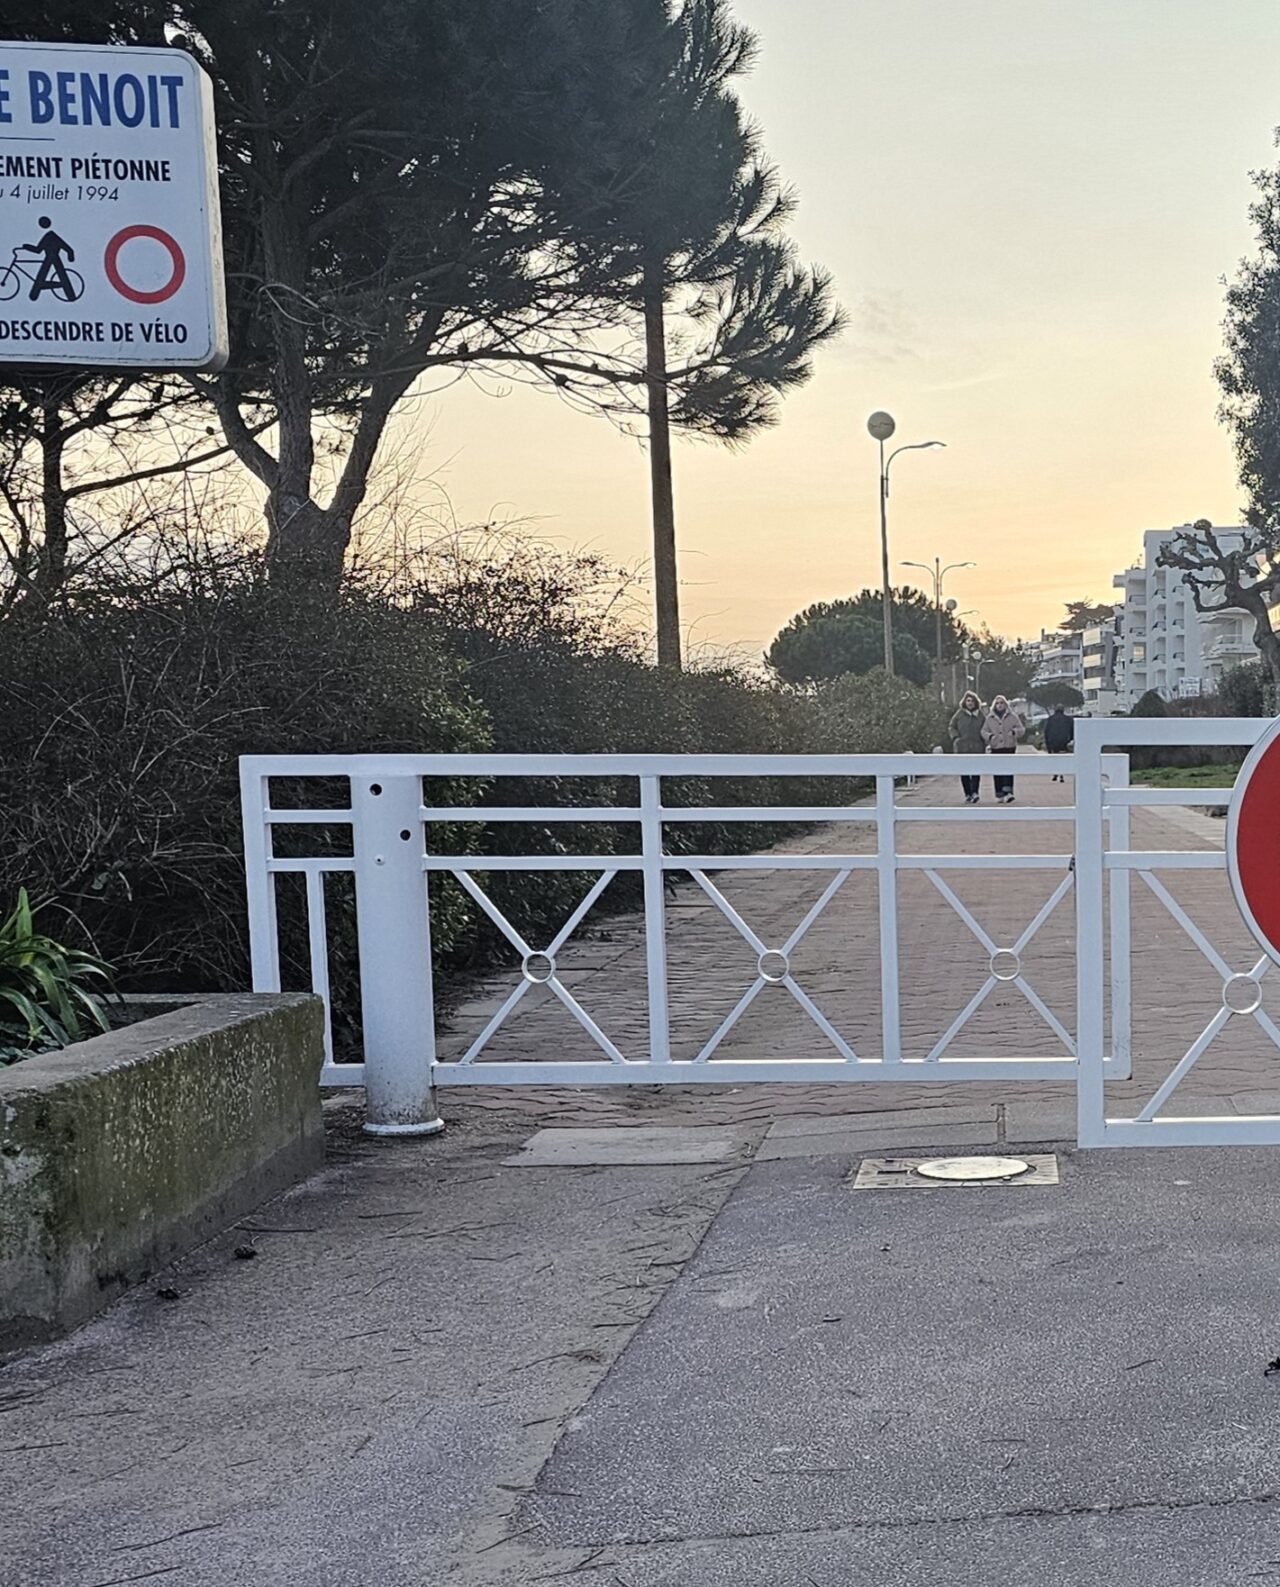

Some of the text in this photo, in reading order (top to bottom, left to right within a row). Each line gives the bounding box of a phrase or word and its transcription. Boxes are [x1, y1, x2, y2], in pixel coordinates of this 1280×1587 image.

[28, 70, 184, 129] BENOIT
[71, 153, 171, 182] PIÉTONNE
[10, 184, 21, 199] 4
[27, 184, 70, 205] juillet
[78, 185, 119, 202] 1994
[0, 318, 188, 344] DESCENDRE DE VÉLO
